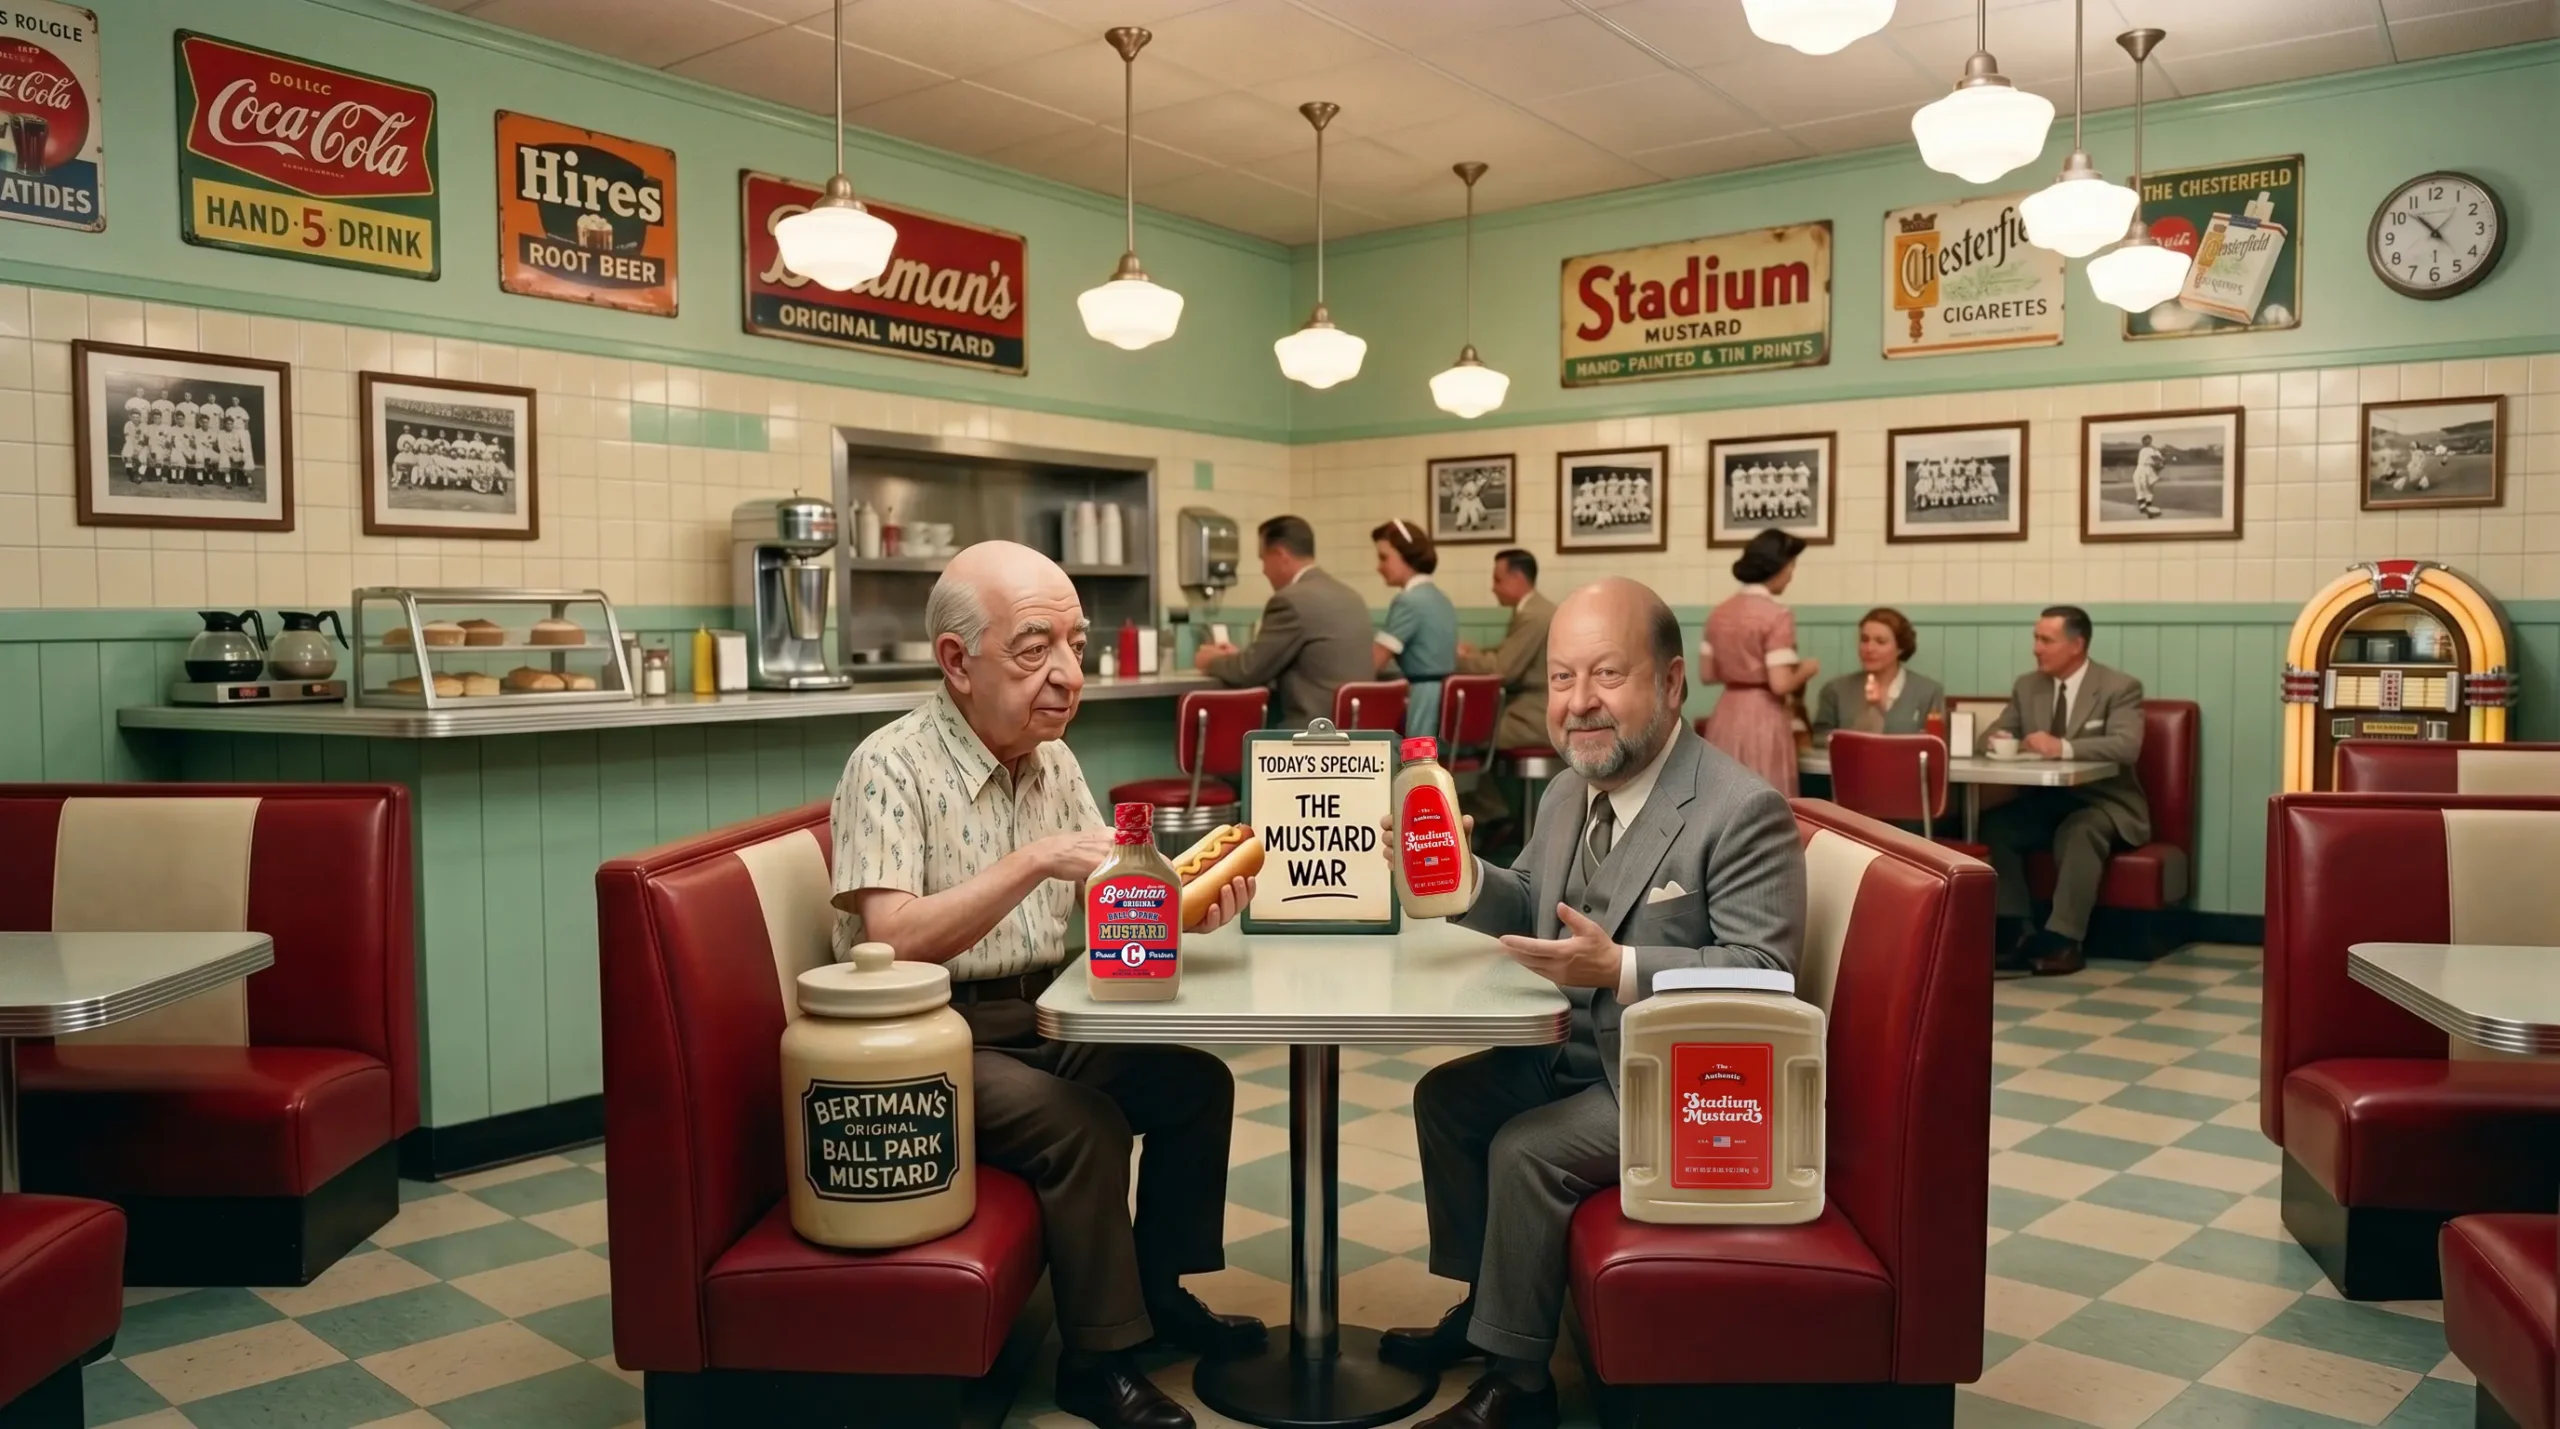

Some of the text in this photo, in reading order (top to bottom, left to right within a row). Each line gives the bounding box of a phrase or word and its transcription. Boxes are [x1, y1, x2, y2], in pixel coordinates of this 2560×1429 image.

[0, 71, 76, 110] a-Cola
[208, 78, 417, 178] Coca-Cola
[520, 146, 662, 223] Hires
[2143, 168, 2292, 202] THE CHESTERFELD
[2428, 187, 2443, 201] 12
[2409, 196, 2418, 209] 11
[2468, 203, 2478, 216] 2
[2390, 212, 2406, 225] 10
[2475, 222, 2485, 236] 3
[338, 218, 422, 260] DRINK
[2385, 232, 2395, 246] 9
[2392, 252, 2401, 265] 8
[2467, 245, 2477, 257] 4
[529, 243, 656, 284] ROOT BEER
[2408, 265, 2418, 280] 7
[2452, 259, 2462, 273] 5
[2429, 267, 2440, 282] 6
[1577, 255, 1810, 342] Stadium
[1943, 298, 2048, 324] CIGARETES
[779, 304, 995, 358] ORIGINAL MUSTARD
[1645, 319, 1742, 344] MUSTARD
[1702, 350, 1714, 365] &
[1718, 347, 1746, 363] TIN
[1752, 340, 1814, 360] PRINTS
[1258, 755, 1385, 774] TODAY'S SPECIAL:
[1295, 794, 1341, 819] THE
[1265, 825, 1376, 852] MUSTARD
[1405, 830, 1453, 843] Stadium
[1405, 838, 1455, 852] Mustard
[1287, 859, 1347, 887] WAR
[1099, 885, 1168, 904] Bertman
[1122, 900, 1156, 908] ORIGINAL
[1107, 910, 1159, 921] BALL PARK
[1099, 923, 1168, 941] MUSTARD
[1095, 951, 1117, 959] Proud
[1148, 951, 1174, 959] Partner
[1704, 1072, 1741, 1081] Authentic
[813, 1089, 947, 1125] BERTMAN'S
[1683, 1092, 1761, 1111] Stadium
[1682, 1106, 1763, 1125] Mustard
[844, 1122, 918, 1136] ORIGINAL
[822, 1132, 942, 1162] BALL PARK
[829, 1161, 938, 1188] MUSTARD
